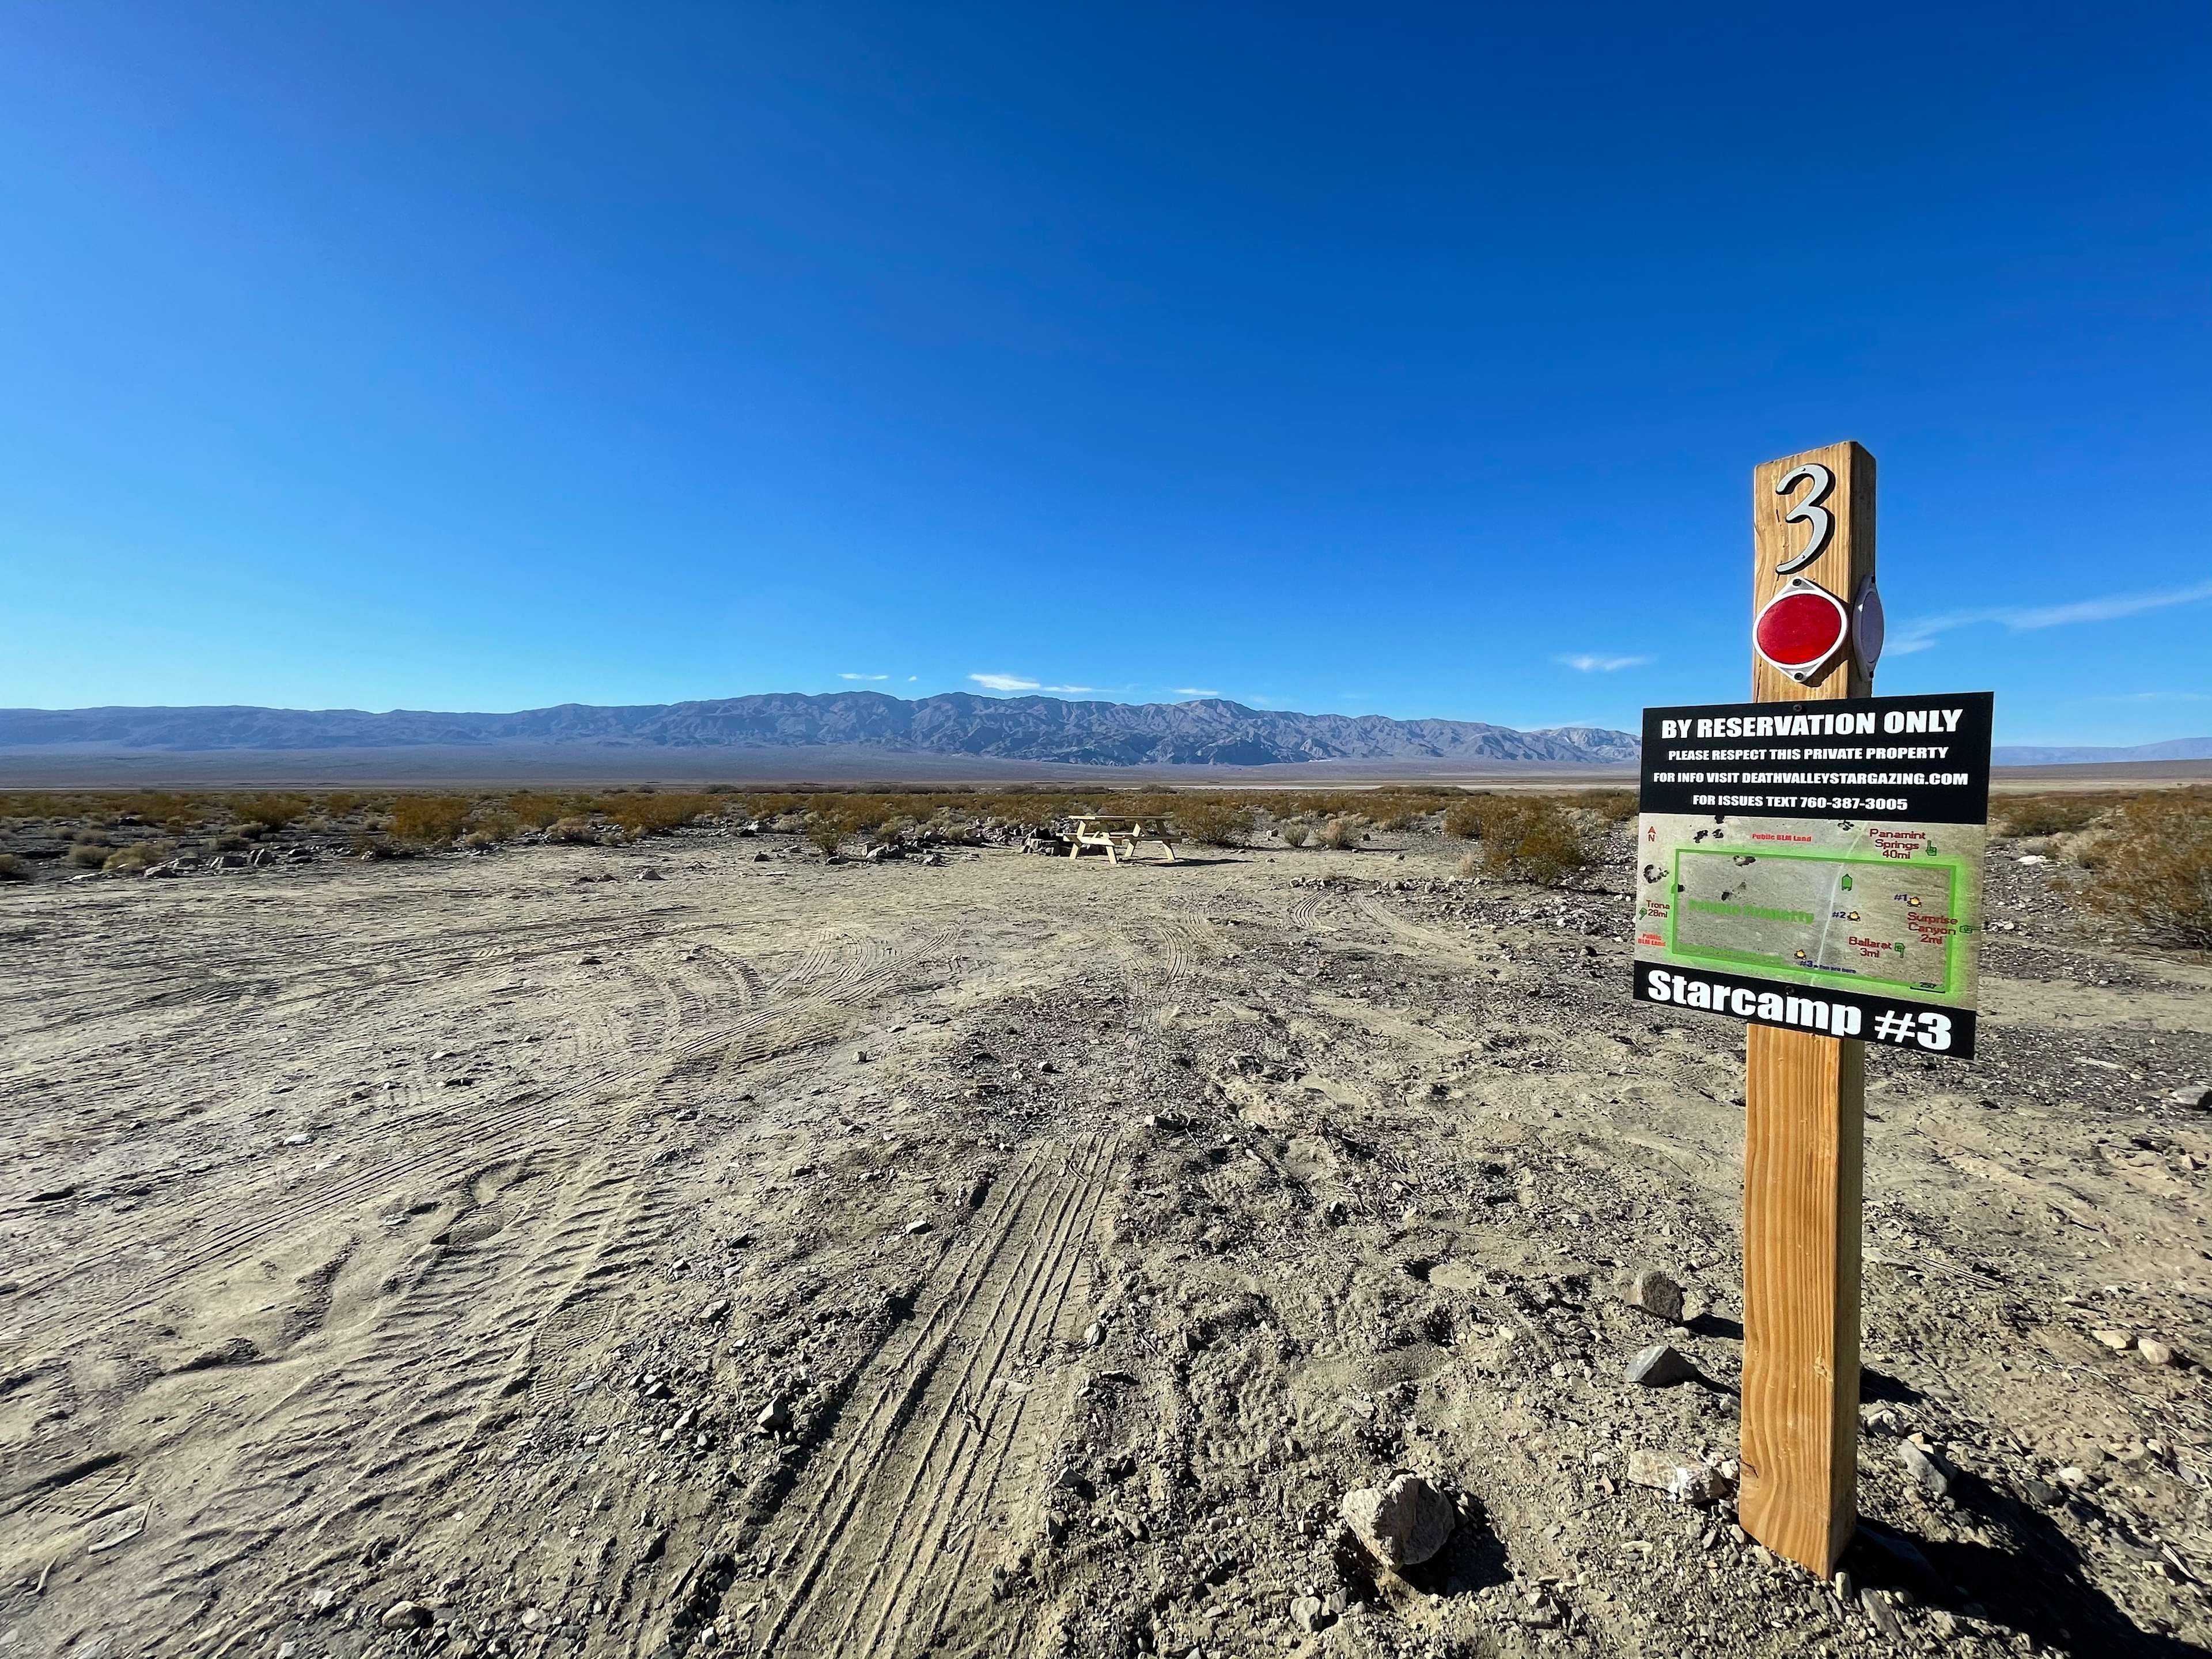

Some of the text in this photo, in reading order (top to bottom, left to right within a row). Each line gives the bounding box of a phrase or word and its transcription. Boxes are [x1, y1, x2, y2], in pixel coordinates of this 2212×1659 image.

[1775, 463, 1834, 575] 3
[1661, 709, 1963, 739] BY RESERVATION ONLY
[1668, 747, 1949, 761] PLEASE RESPECT THIS PRIVATE PROPERTY
[1653, 772, 1968, 785] FOR INFO VISIT DEATHVALLEYSTARGAZING.COM
[1692, 794, 1908, 810] FOR ISSUES TEXT 760-387-3005
[1870, 828, 1926, 839] Panamint
[1874, 839, 1919, 851] Springs
[1882, 849, 1911, 859] 40mi
[1646, 900, 1670, 910] Trona
[1647, 908, 1668, 918] 28mi
[1907, 912, 1958, 925] Surprise
[1908, 922, 1956, 935] Canyon
[1849, 936, 1892, 950] Ballarat
[1920, 934, 1943, 944] 2mi
[1859, 948, 1880, 957] 3mi
[1647, 969, 1952, 1051] Starcamp #3
